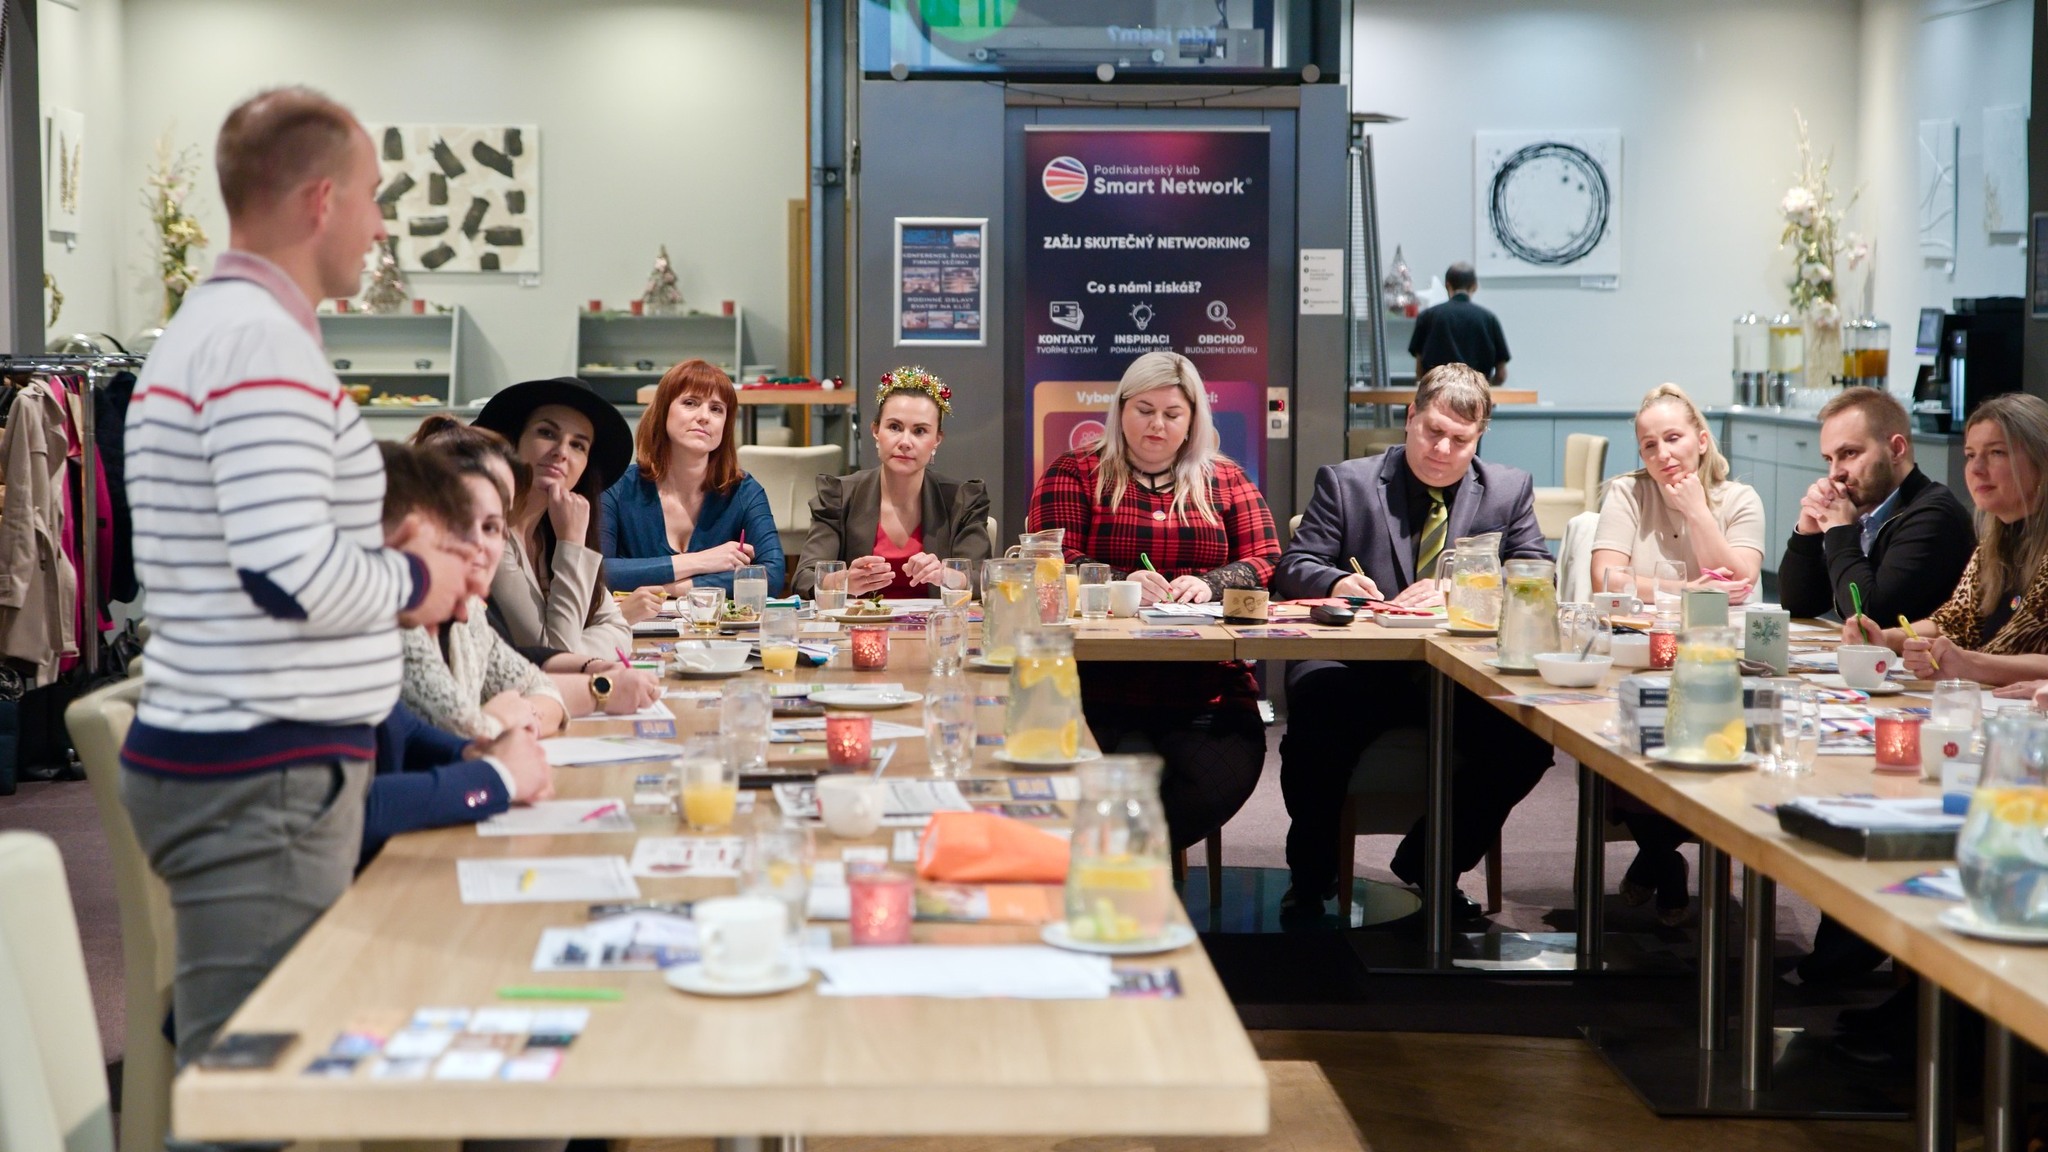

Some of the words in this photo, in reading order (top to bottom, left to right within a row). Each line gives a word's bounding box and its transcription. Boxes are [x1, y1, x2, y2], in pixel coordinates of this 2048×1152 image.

[1094, 165, 1174, 176] Podnikatelský
[1176, 165, 1200, 175] klub
[1094, 178, 1155, 194] Smart
[1043, 234, 1082, 249] ZAŽIJ
[1085, 234, 1154, 249] SKUTEČNÝ
[1157, 237, 1250, 249] NETWORKING
[1087, 282, 1106, 293] Co
[1109, 285, 1116, 293] s
[1119, 281, 1151, 293] námi
[1155, 281, 1201, 293] získáš?
[1038, 334, 1095, 344] KONTAKTY
[1114, 334, 1170, 344] INSPIRACI
[1198, 334, 1245, 344] OBCHOD
[1036, 346, 1067, 354] TVOŘÍME
[1227, 346, 1258, 354] DŮVĚRU
